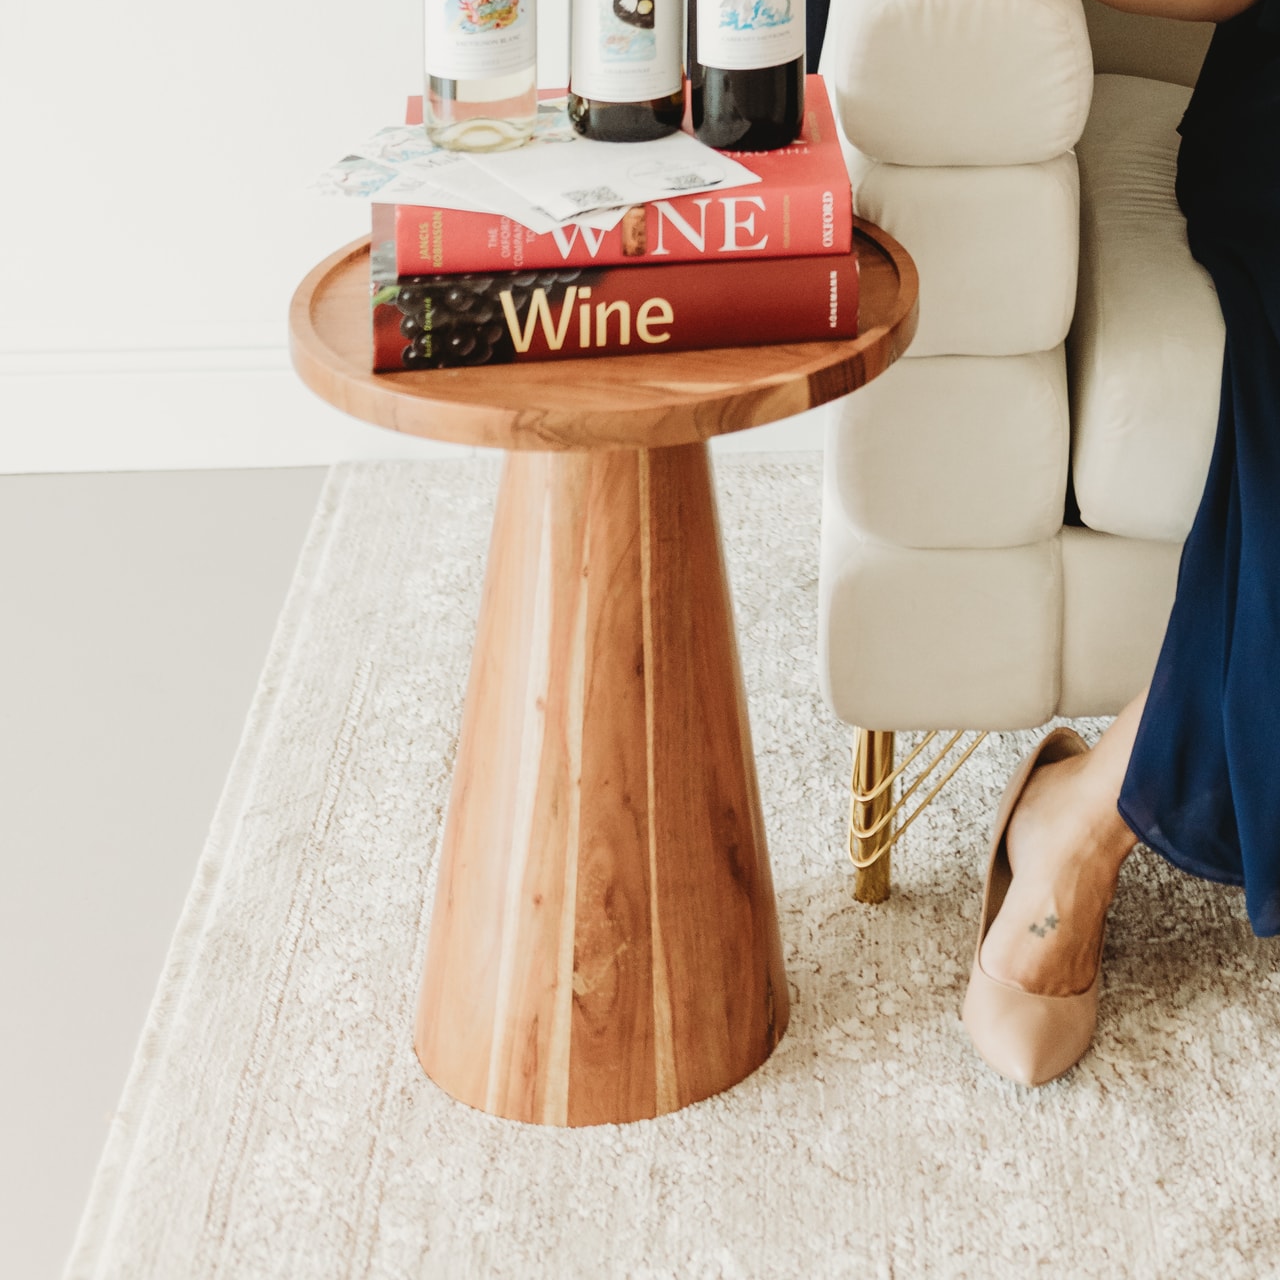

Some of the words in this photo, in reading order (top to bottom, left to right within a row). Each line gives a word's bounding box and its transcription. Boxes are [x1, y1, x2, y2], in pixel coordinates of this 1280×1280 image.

[419, 222, 431, 260] JANCIS
[432, 211, 443, 268] ROBINSON
[488, 227, 499, 248] THE
[822, 191, 834, 248] OXFORD
[499, 285, 674, 354] Wine
